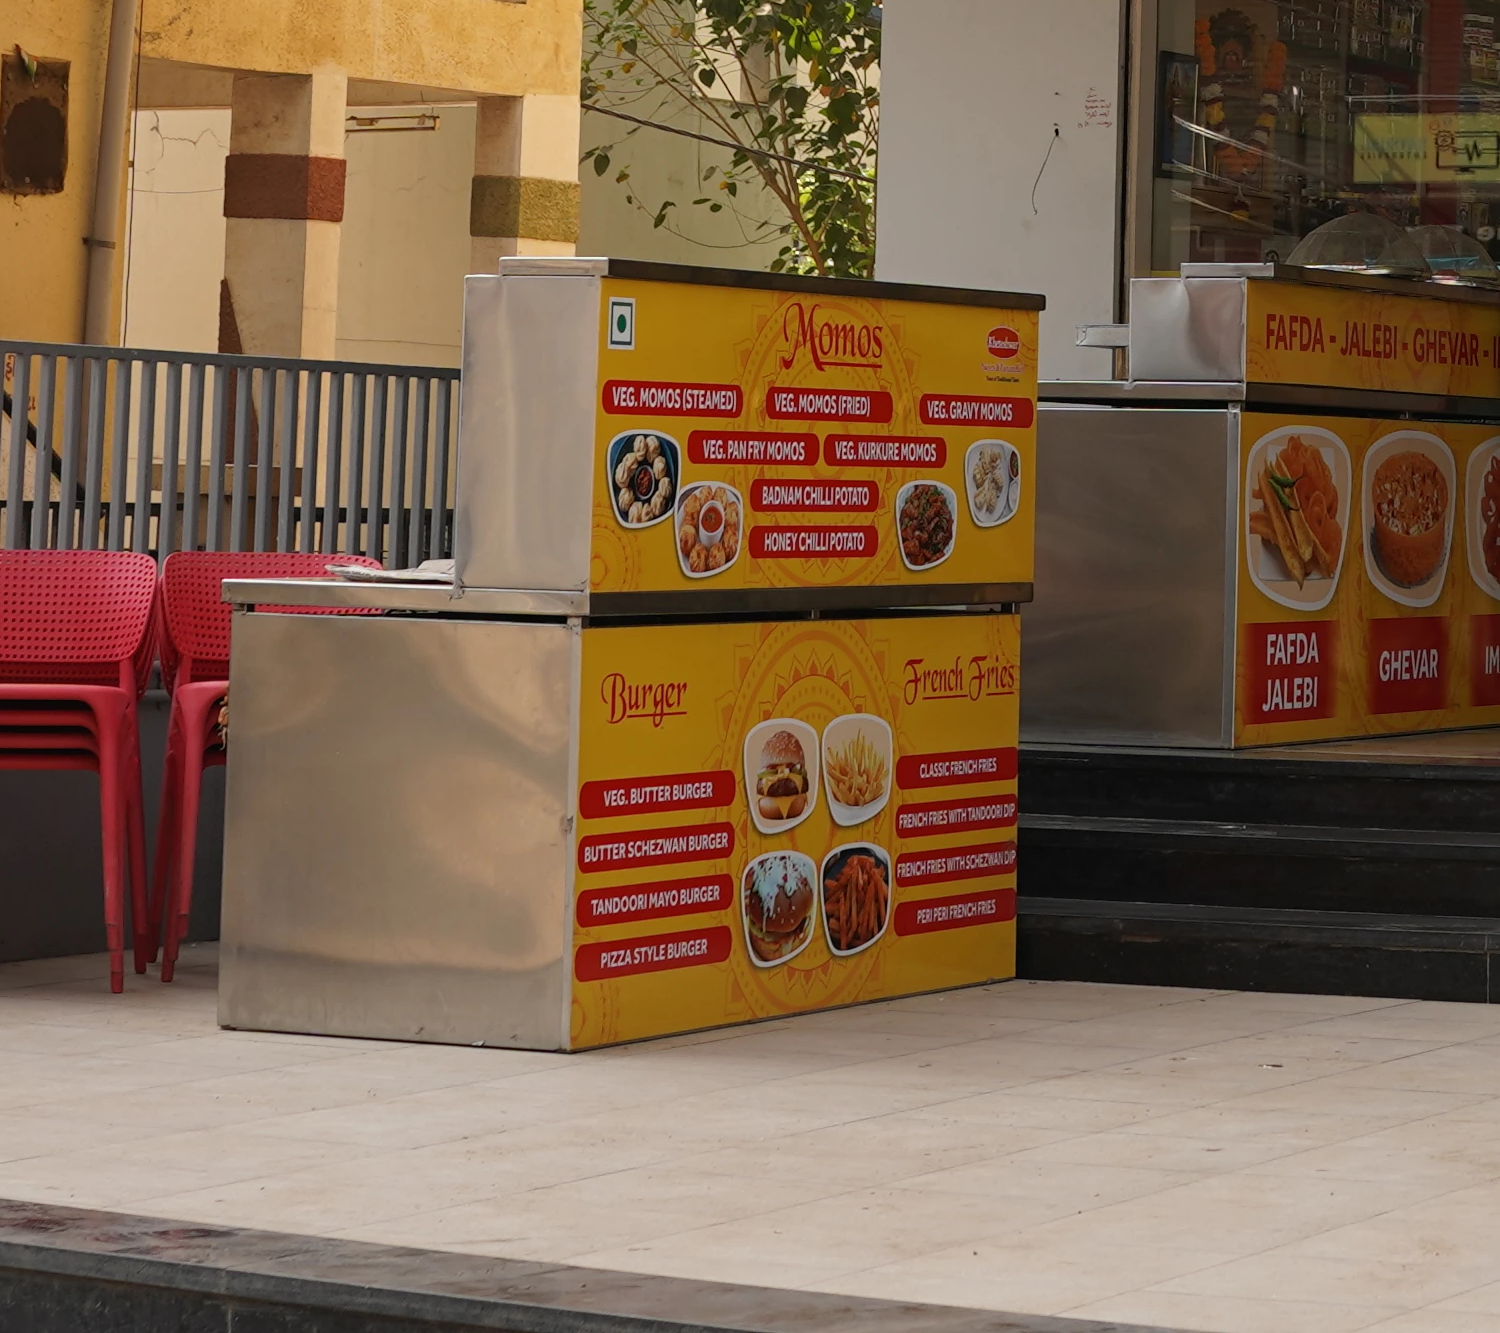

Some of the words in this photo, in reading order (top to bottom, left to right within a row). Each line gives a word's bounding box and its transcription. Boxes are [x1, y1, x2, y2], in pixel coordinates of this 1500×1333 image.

[782, 303, 883, 372] Momos
[1266, 314, 1325, 353] FAFDA
[1340, 321, 1397, 360] JALEBI
[1413, 328, 1479, 367] GHEVAR
[613, 387, 637, 407] VEG.
[640, 387, 680, 409] MOMOS
[683, 388, 736, 412] (STEAMED)
[775, 393, 797, 412] VEG.
[799, 394, 836, 415] MOMOS
[839, 395, 870, 417] (FRIED)
[927, 400, 948, 419] VEG.
[950, 402, 980, 420] GRAVY
[981, 403, 1013, 421] MOMOS
[703, 440, 726, 459] VEG.
[728, 440, 748, 460] PAN
[748, 441, 766, 460] FRY
[767, 441, 805, 461] MOMOS
[835, 441, 857, 459] VEG.
[858, 442, 899, 460] KURKURE
[901, 443, 936, 461] MOMOS
[762, 485, 801, 505] BADNAM
[803, 486, 834, 506] CHILLI
[834, 486, 869, 506] POTATO
[764, 531, 797, 551] HONEY
[799, 532, 829, 552] CHILLI
[829, 532, 865, 552] POTATO
[1265, 631, 1318, 667] FAFDA
[1378, 648, 1439, 682] GHEVAR
[903, 655, 964, 705] French
[968, 655, 1015, 701] Fries
[1261, 674, 1318, 712] JALEBI
[601, 673, 688, 728] Burger
[920, 764, 949, 778] CLASSIC
[950, 760, 978, 775] FRENCH
[978, 758, 997, 773] FRIES
[604, 789, 628, 807] VEG.
[630, 785, 671, 804] BUTTER
[673, 782, 713, 800] BURGER
[899, 813, 928, 829] FRENCH
[928, 811, 948, 826] FRIES
[949, 808, 967, 823] WITH
[968, 805, 1002, 821] TANDOORI
[1003, 803, 1015, 818] DIP
[584, 844, 625, 863] BUTTER
[628, 837, 686, 858] SCHEZWAN
[689, 833, 728, 851] BURGER
[897, 861, 926, 878] FRENCH
[927, 858, 946, 874] FRIES
[947, 856, 965, 871] WITH
[966, 851, 1004, 870] SCHEZWAN
[1005, 850, 1016, 865] DIP
[591, 894, 647, 916] TANDOORI
[649, 892, 678, 909] MAYO
[680, 885, 720, 904] BURGER
[917, 909, 932, 924] PERI
[933, 906, 949, 922] PERI
[950, 902, 977, 919] FRENCH
[978, 899, 996, 915] FRIES
[601, 951, 631, 969] PIZZA
[633, 945, 665, 964] STYLE
[667, 939, 707, 959] BURGER
